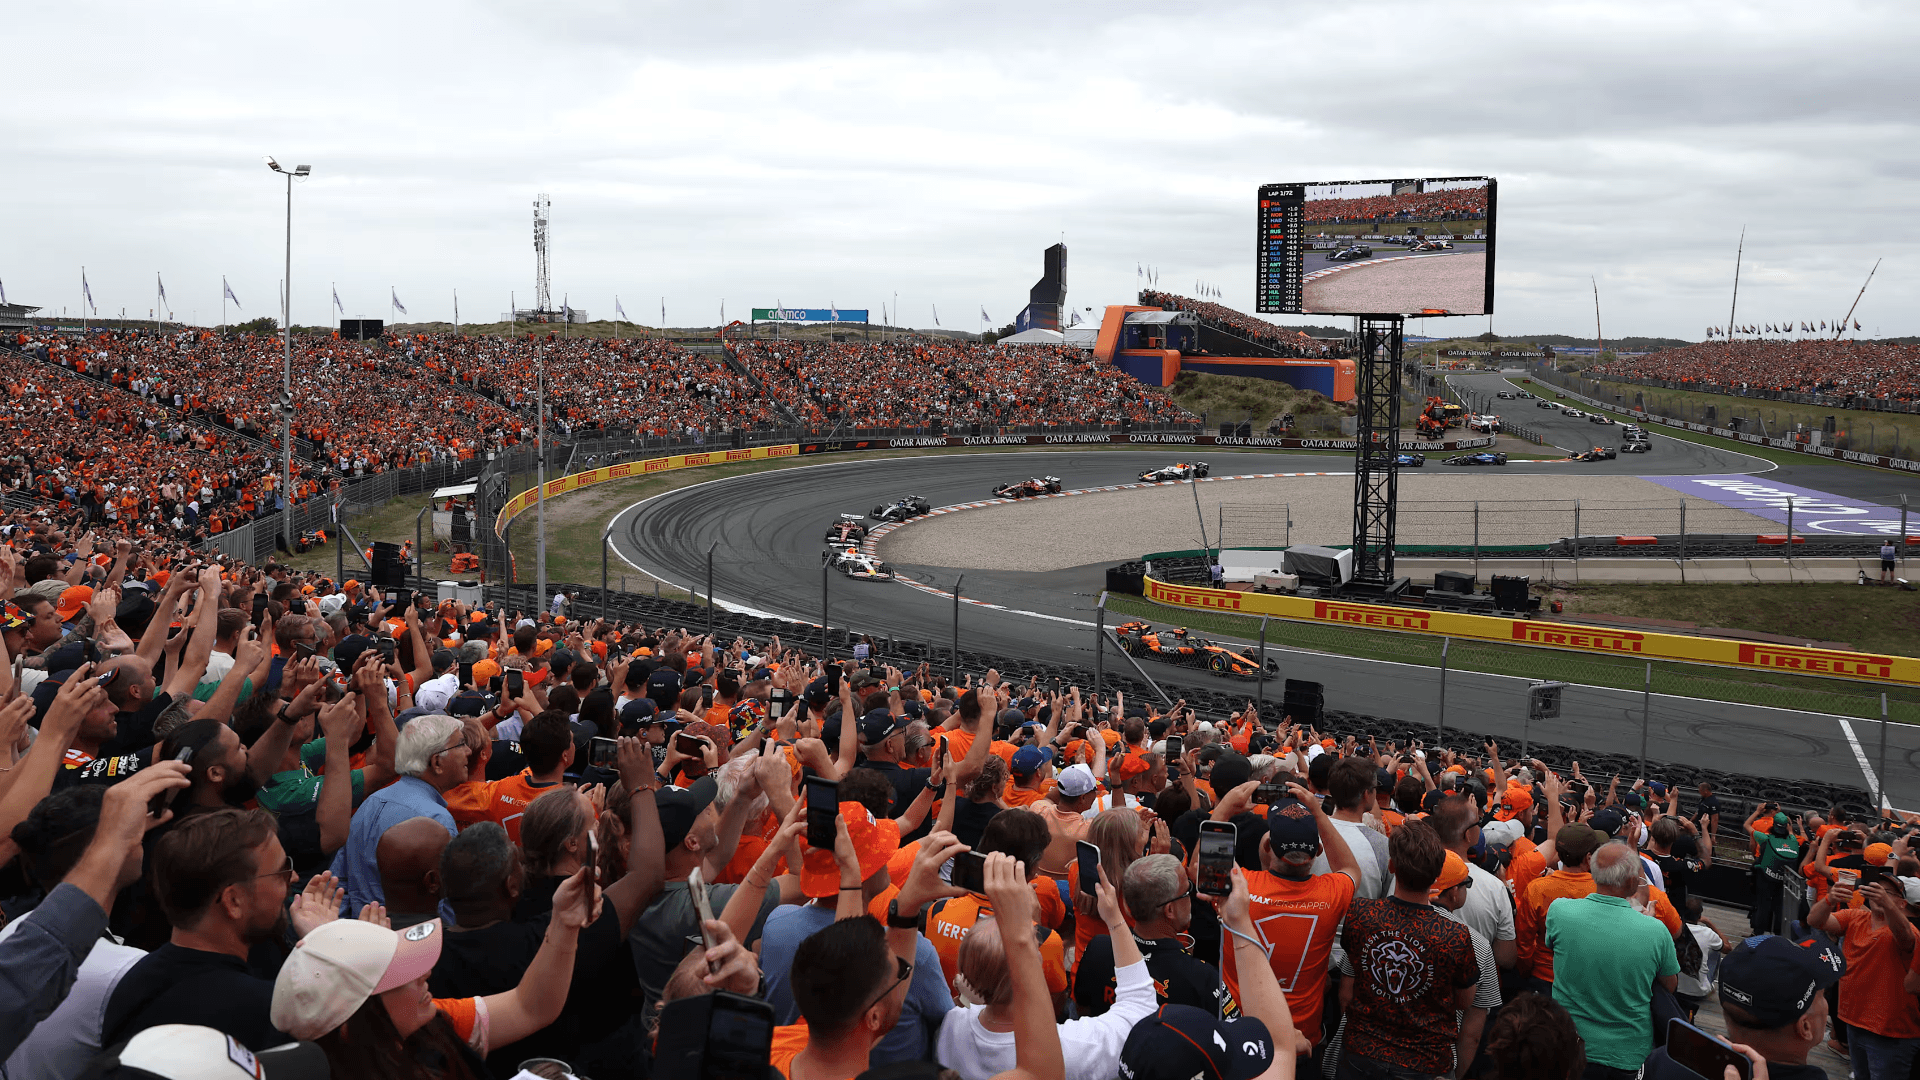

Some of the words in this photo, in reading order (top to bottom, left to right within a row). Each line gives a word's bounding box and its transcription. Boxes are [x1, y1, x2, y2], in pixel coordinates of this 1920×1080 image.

[768, 310, 806, 320] armco
[890, 438, 914, 447] QATAR
[915, 438, 947, 446] AIRWAYS
[964, 436, 990, 445] QATAR
[1045, 435, 1073, 443] QATAR
[1160, 435, 1196, 443] AIRWAYS
[1215, 436, 1244, 445] QATAR
[1246, 437, 1282, 446] AIRWAYS
[1301, 439, 1329, 448] QATAR
[1331, 440, 1358, 448] AIRWA
[1456, 441, 1471, 449] QATAR
[1804, 444, 1816, 453] QATAR
[726, 450, 751, 460] PIRELLI
[768, 446, 792, 456] PIRELLI
[685, 454, 709, 465] PIRELLI
[1843, 450, 1858, 460] QATAR
[1859, 453, 1879, 464] AIRWAYS
[645, 459, 668, 471] PIRELLI
[1889, 459, 1907, 469] QATAR
[609, 465, 630, 477] PIRELLI
[578, 471, 597, 485] PIRELLI
[549, 479, 566, 494] PIRELLI
[1152, 582, 1242, 609] PIRELLI
[1315, 601, 1430, 629] PIRELLI
[1512, 622, 1644, 651] PIRELLI
[1739, 644, 1893, 677] PIRELLI
[1362, 933, 1379, 971] UNLEASH
[1404, 934, 1425, 952] LION
[1413, 964, 1434, 999] UNLEASH
[1371, 984, 1391, 1000] LION
[1395, 995, 1411, 1004] THE
